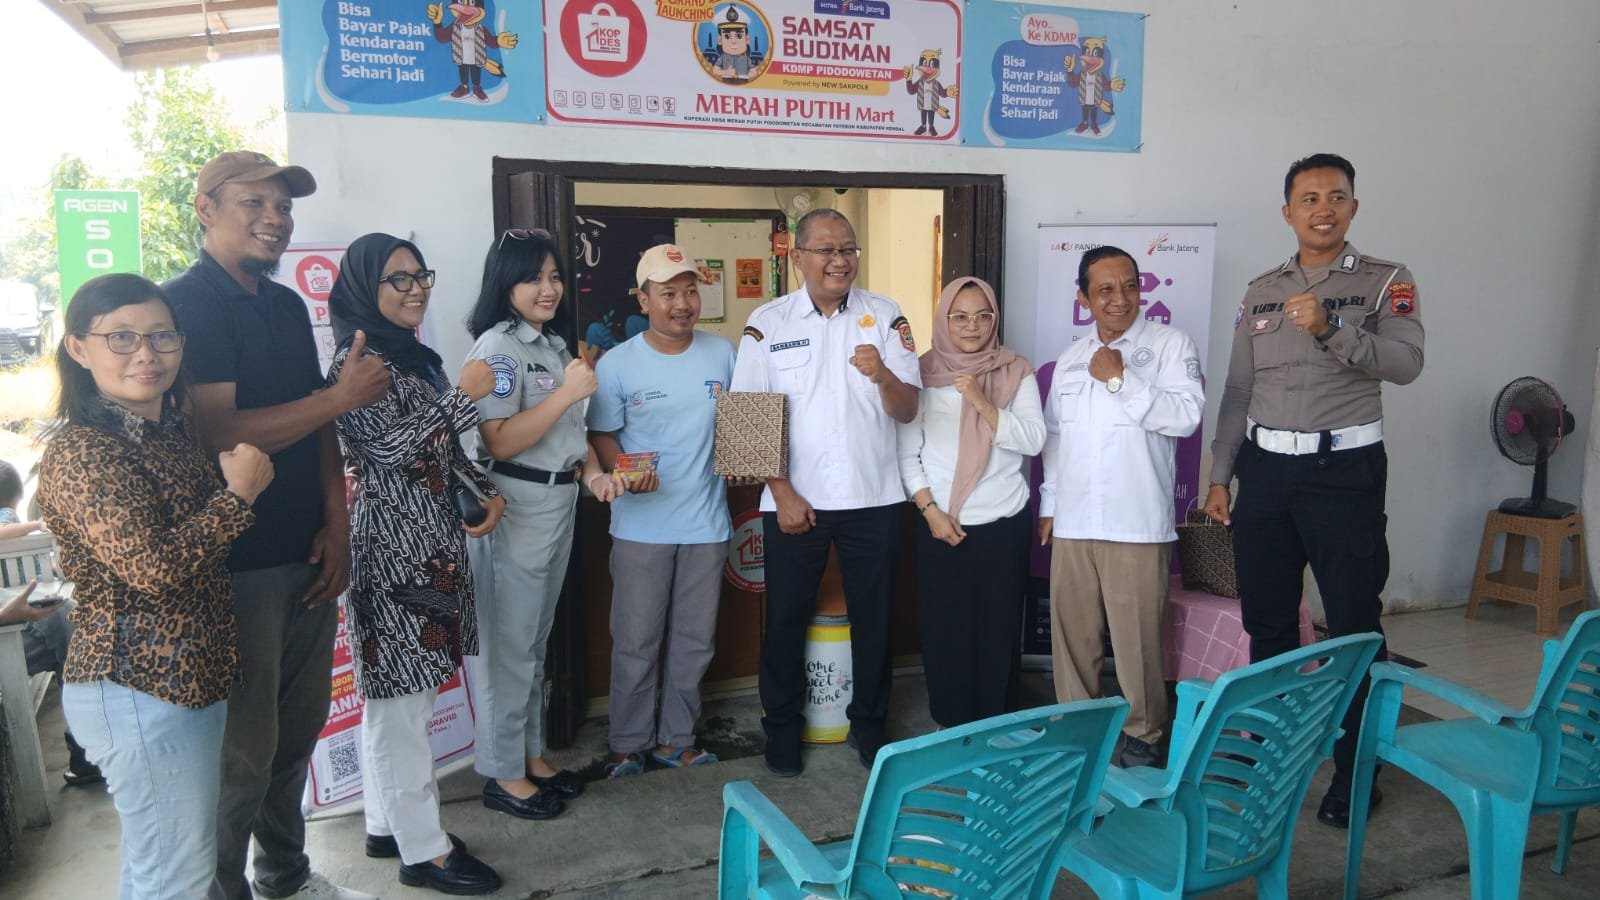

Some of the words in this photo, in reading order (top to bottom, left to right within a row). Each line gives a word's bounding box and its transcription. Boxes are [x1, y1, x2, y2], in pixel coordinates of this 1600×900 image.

[338, 1, 371, 17] Bisa
[656, 1, 714, 20] LAUNCHING
[849, 3, 865, 12] Bank
[338, 17, 386, 35] Bayar
[389, 21, 432, 37] Pajak
[600, 28, 621, 38] KOP
[782, 16, 875, 40] SAMSAT
[339, 33, 425, 51] Kendaraan
[600, 38, 621, 47] DES
[1027, 30, 1041, 41] Ke
[1044, 31, 1077, 42] KDMP
[340, 49, 416, 66] Bermotor
[782, 38, 891, 63] BUDIMAN
[1003, 55, 1025, 67] Bisa
[341, 64, 392, 80] Sehari
[395, 68, 425, 83] Jadi
[782, 63, 813, 74] KDMP
[816, 66, 892, 79] PIDODOWETAN
[1002, 68, 1034, 82] Bayar
[1037, 71, 1066, 83] Pajak
[782, 79, 811, 87] Powered
[1002, 82, 1061, 95] Kendaraan
[695, 93, 778, 117] MERAH
[786, 99, 850, 121] PUTIH
[855, 107, 895, 123] Mart
[1001, 95, 1054, 107] Bermotor
[1001, 107, 1036, 120] Sehari
[1039, 109, 1059, 121] Jadi
[64, 199, 128, 213] AGEN
[1051, 243, 1073, 251] LAKU
[1157, 244, 1175, 252] Bank
[1176, 244, 1200, 253] Jateng
